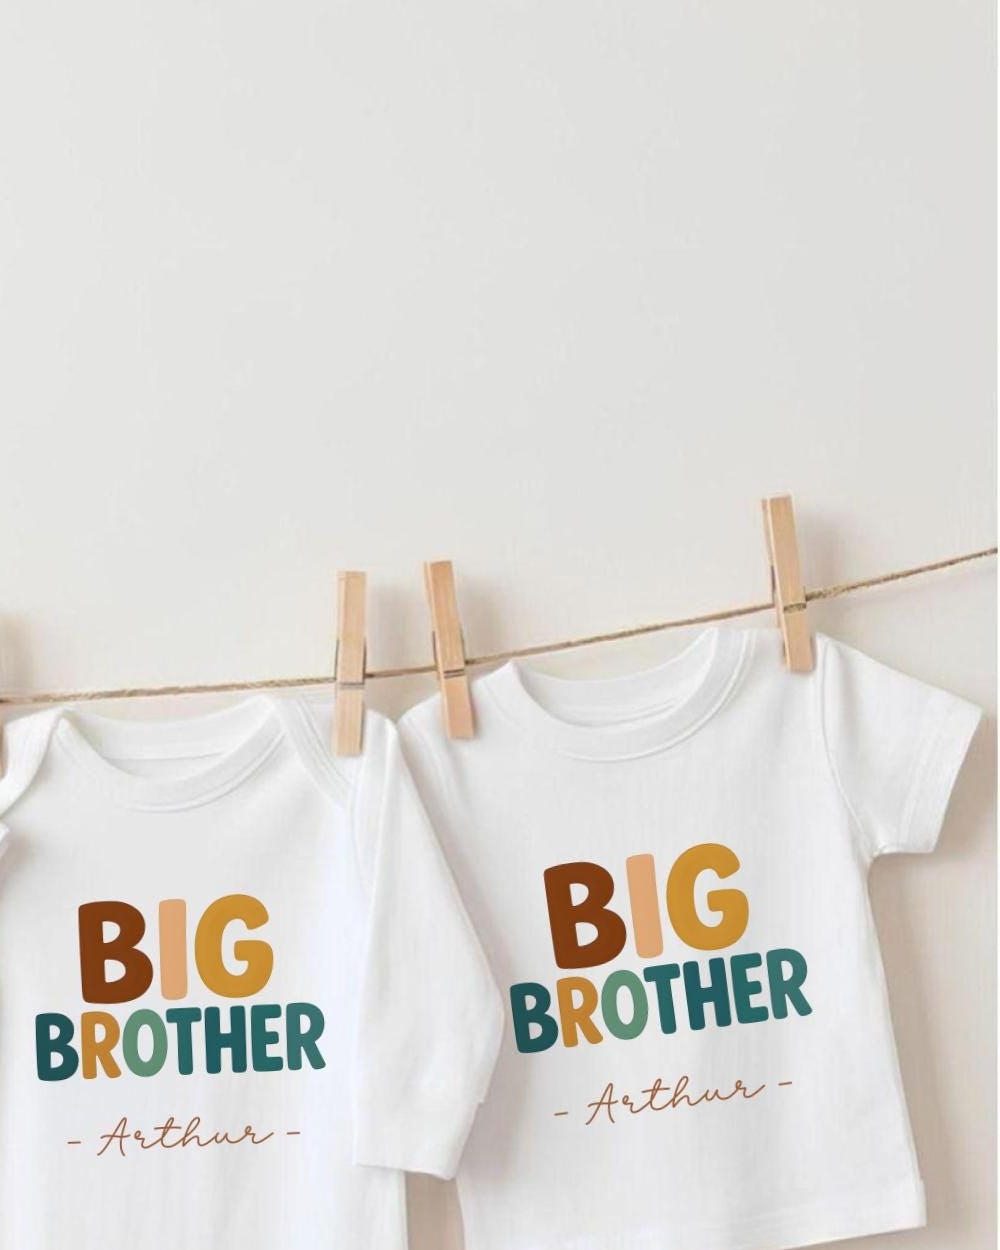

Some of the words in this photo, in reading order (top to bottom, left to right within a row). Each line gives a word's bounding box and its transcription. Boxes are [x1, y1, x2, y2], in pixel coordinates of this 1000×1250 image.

[78, 894, 274, 1006] BIG
[544, 843, 749, 969] BIG
[36, 1002, 325, 1081] BROTHER
[510, 948, 812, 1053] BROTHER
[97, 1116, 275, 1156] Arthur
[585, 1075, 766, 1125] Arthur
